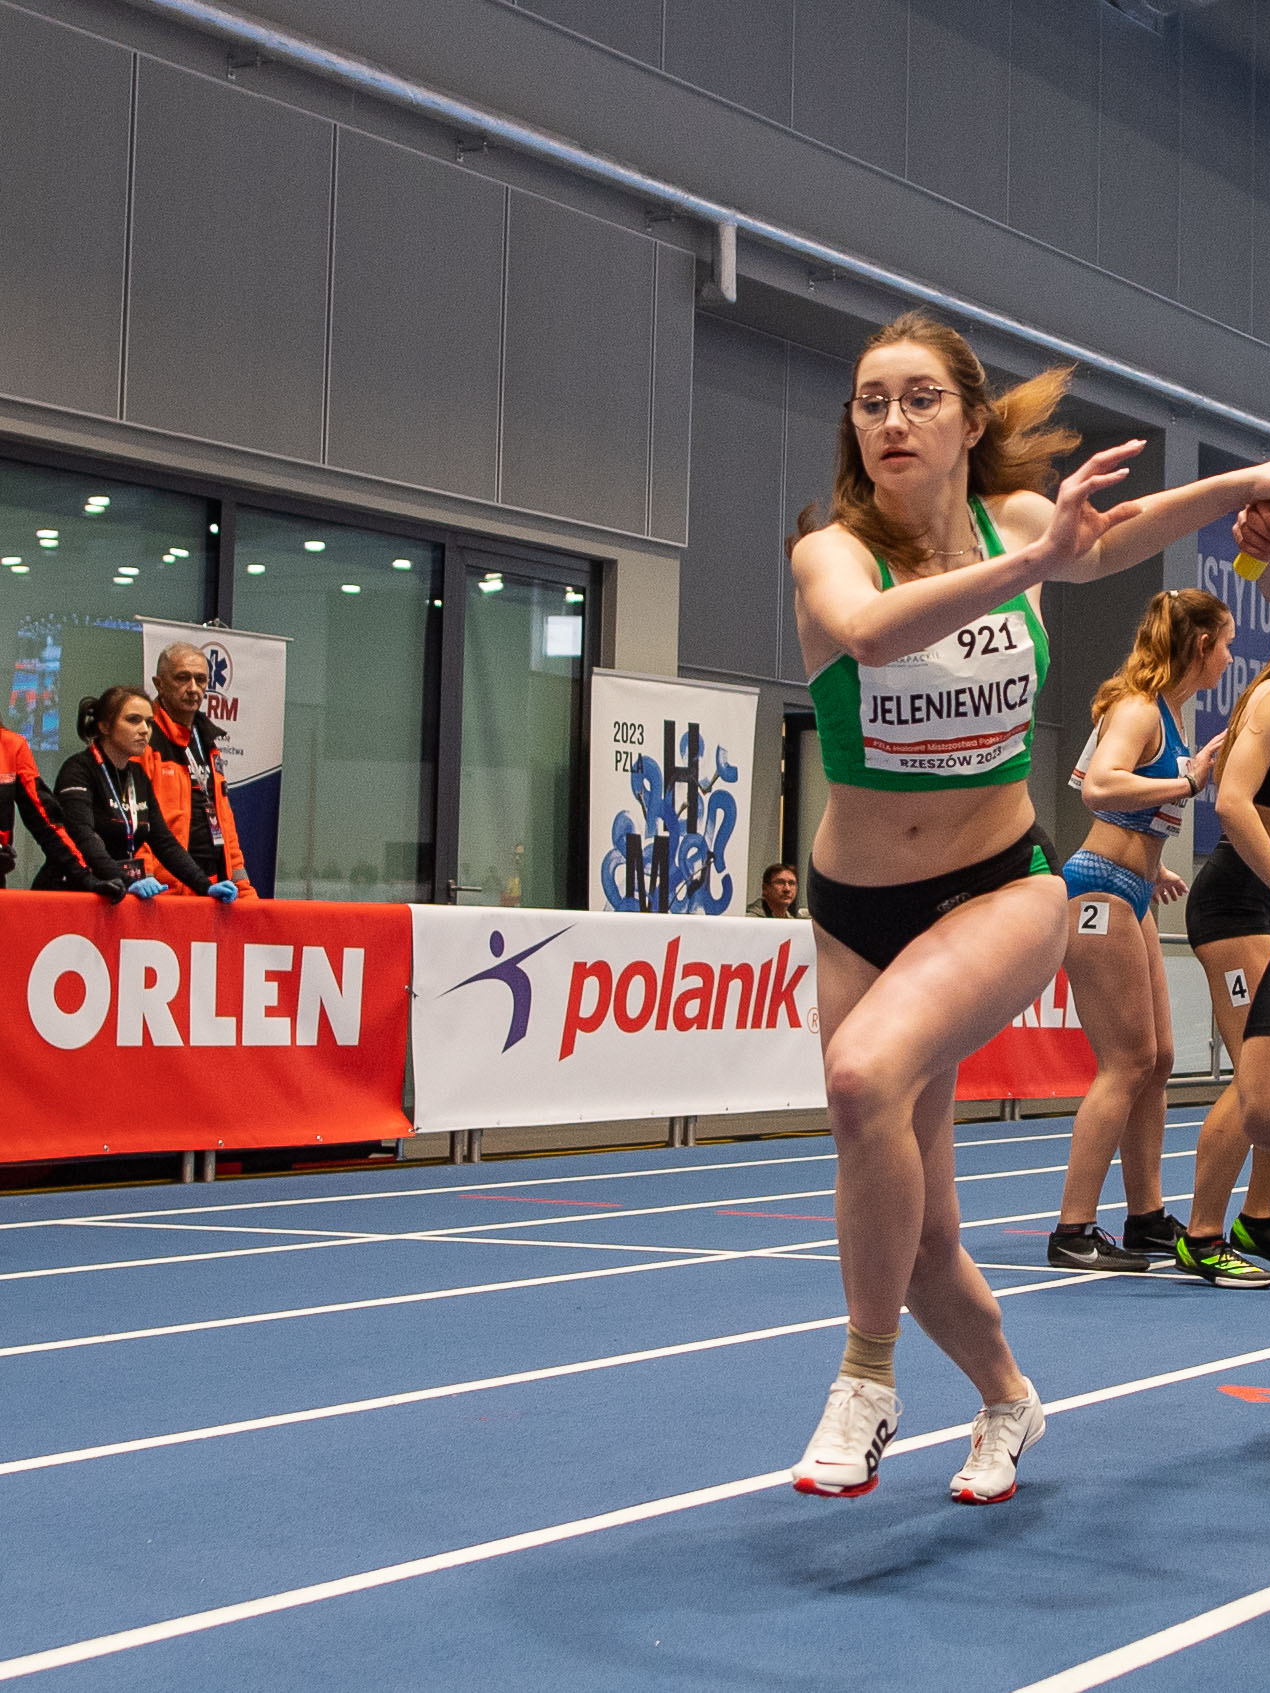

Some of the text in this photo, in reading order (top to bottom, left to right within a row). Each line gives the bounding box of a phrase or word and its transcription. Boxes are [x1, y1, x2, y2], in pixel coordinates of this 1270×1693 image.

[957, 620, 1018, 660] 921
[869, 674, 1030, 726] JELENIEWICZ
[613, 721, 644, 746] 2023
[614, 750, 644, 774] PZLA
[900, 745, 1003, 770] RZESZÓW 2023
[1081, 904, 1098, 929] 2
[27, 933, 365, 1050] ORLEN
[559, 935, 810, 1061] polanik
[1231, 974, 1247, 998] 4
